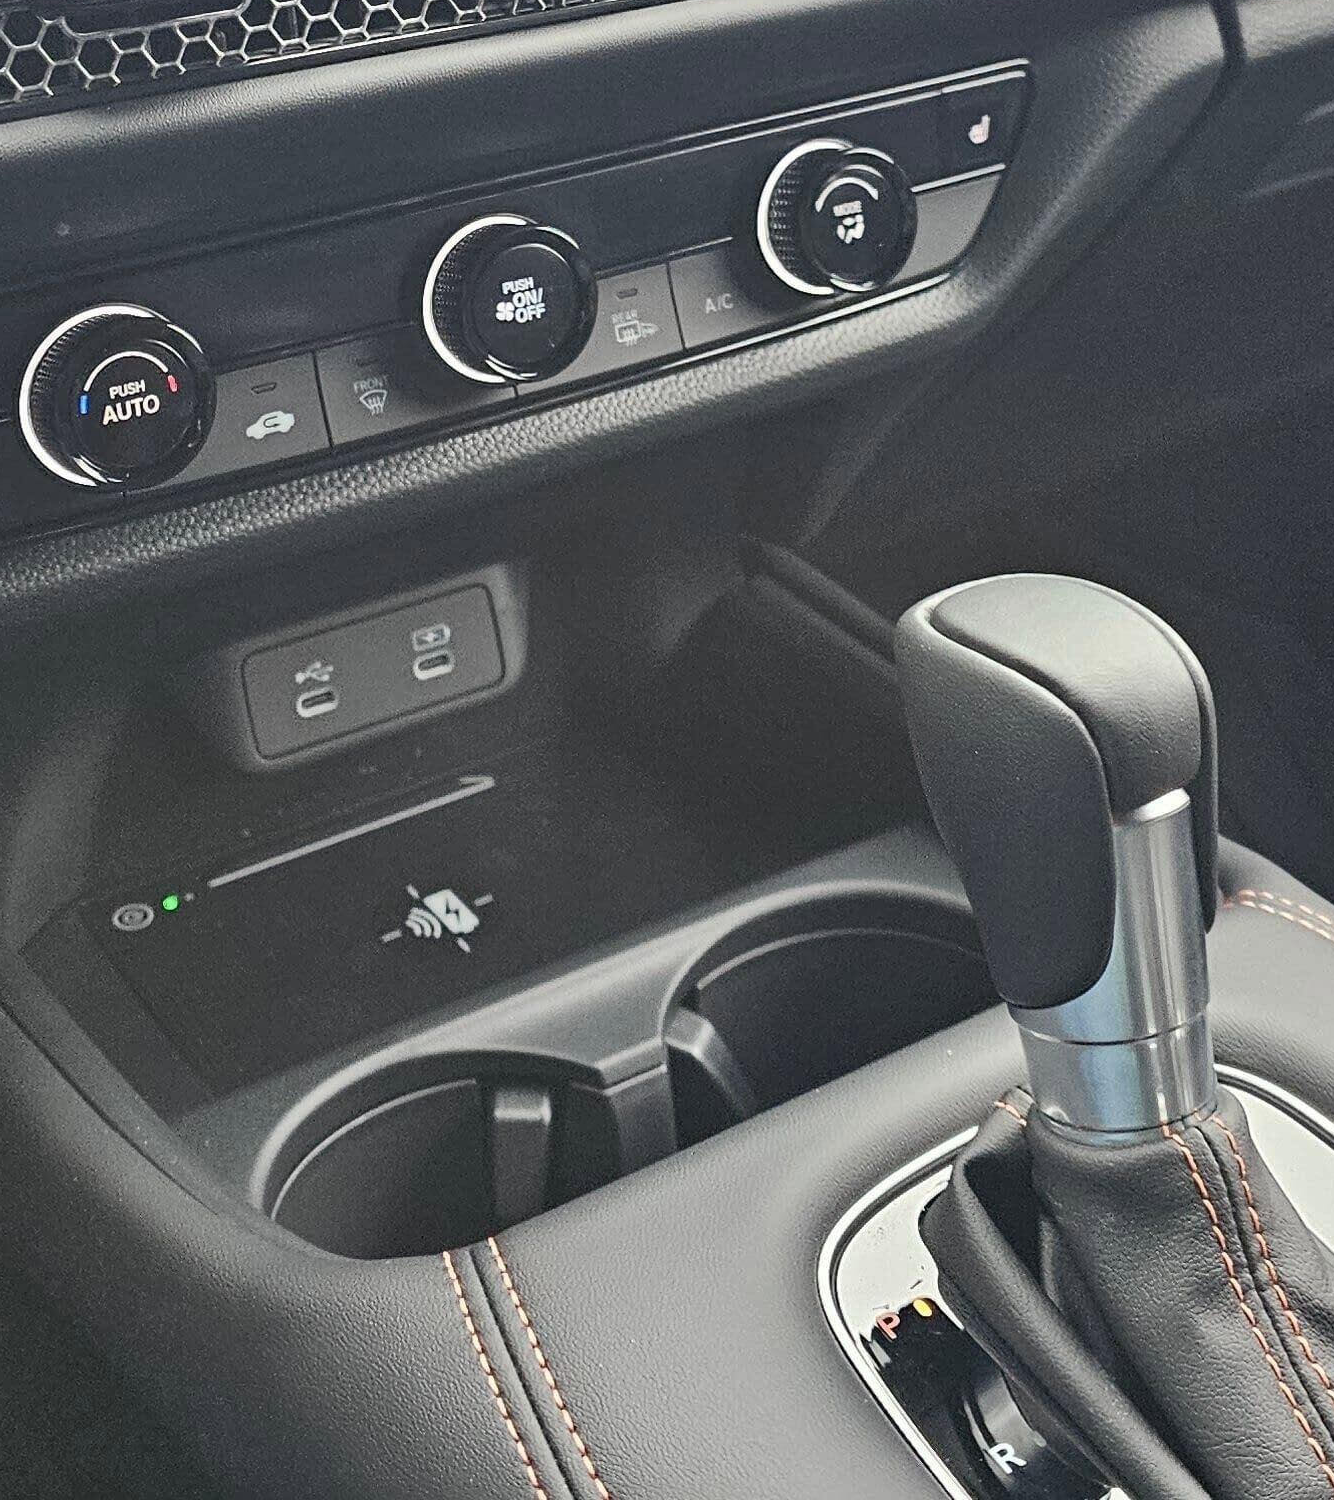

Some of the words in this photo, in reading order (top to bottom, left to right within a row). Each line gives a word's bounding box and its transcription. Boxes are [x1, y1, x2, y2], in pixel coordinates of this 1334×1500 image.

[502, 277, 534, 295] PUSH
[515, 303, 547, 324] OFF
[704, 293, 735, 314] A/C
[109, 379, 146, 399] PUSH
[353, 373, 389, 394] FRONT
[102, 395, 161, 426] AUTO
[876, 1311, 901, 1341] P
[989, 1443, 1027, 1475] R
